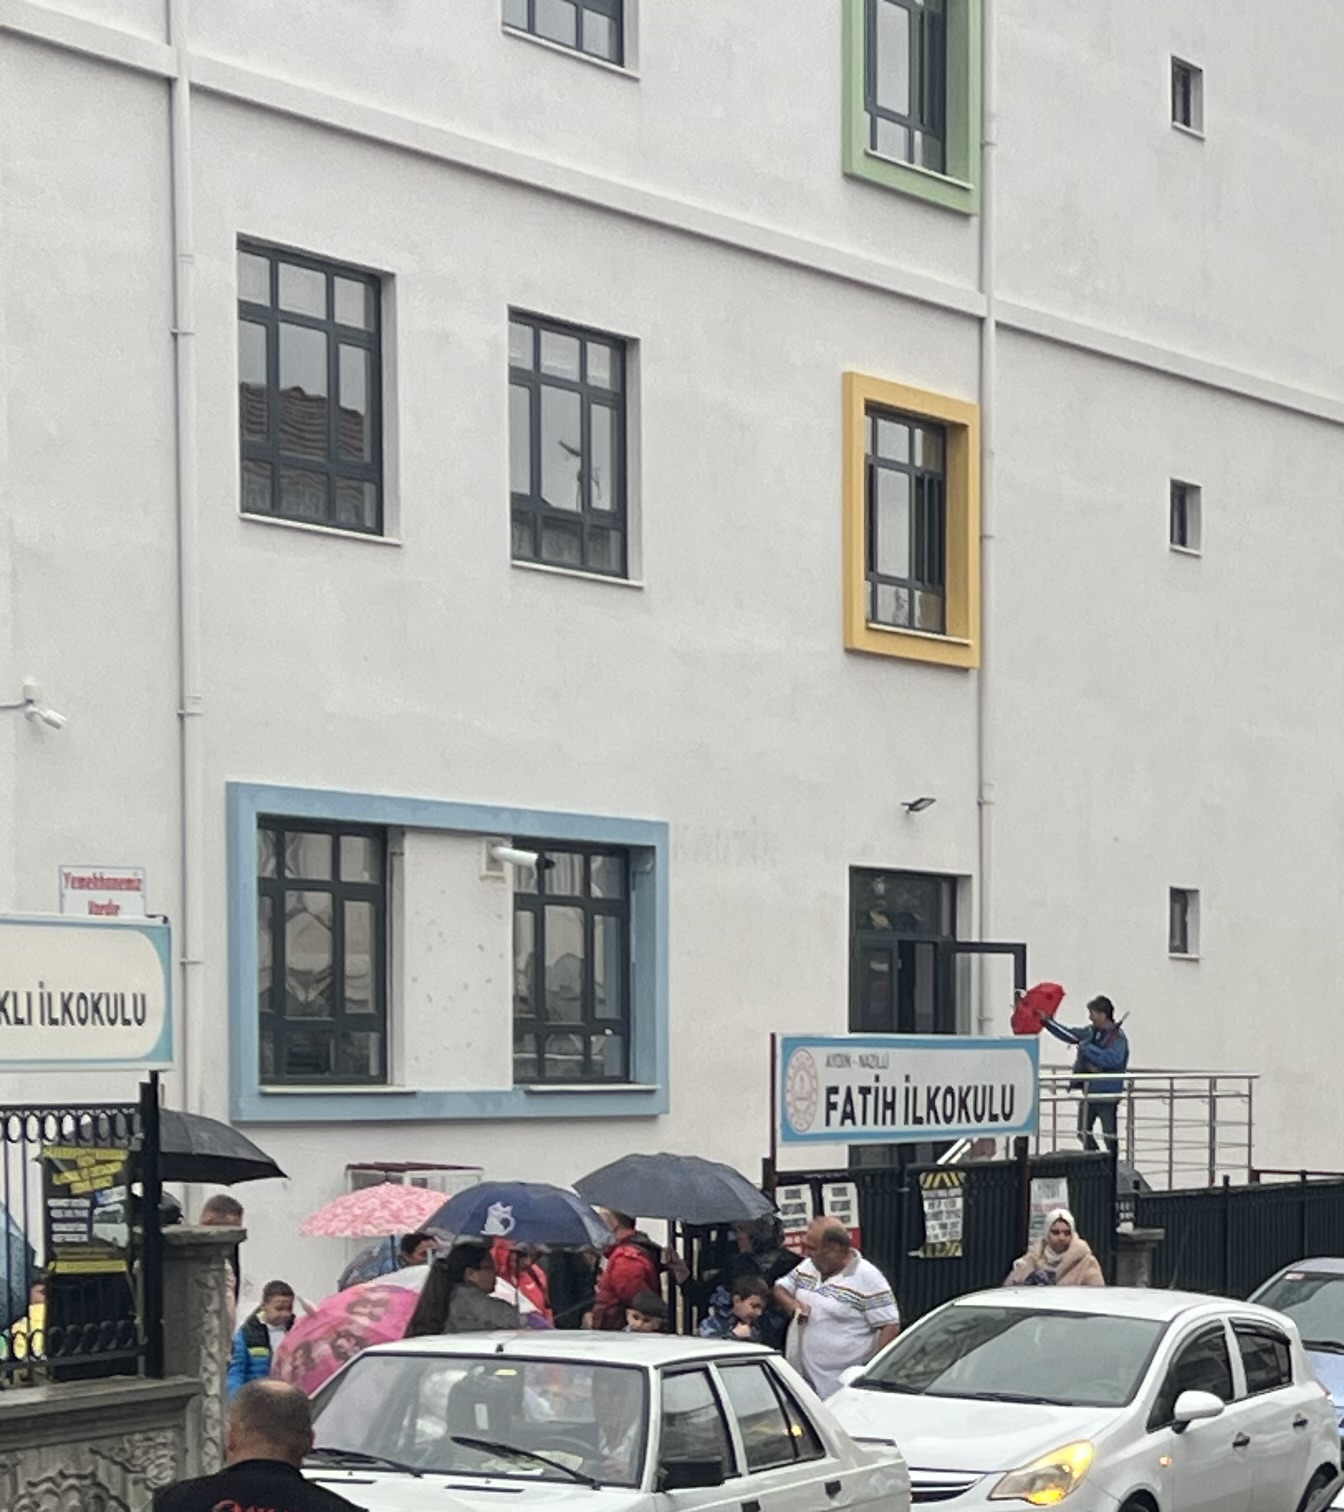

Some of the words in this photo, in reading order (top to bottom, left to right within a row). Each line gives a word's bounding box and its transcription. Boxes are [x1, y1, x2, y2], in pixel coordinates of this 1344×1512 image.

[38, 981, 147, 1027] İLKOKULU
[825, 1074, 896, 1127] FATİH
[903, 1074, 1015, 1126] İLKOKULU
